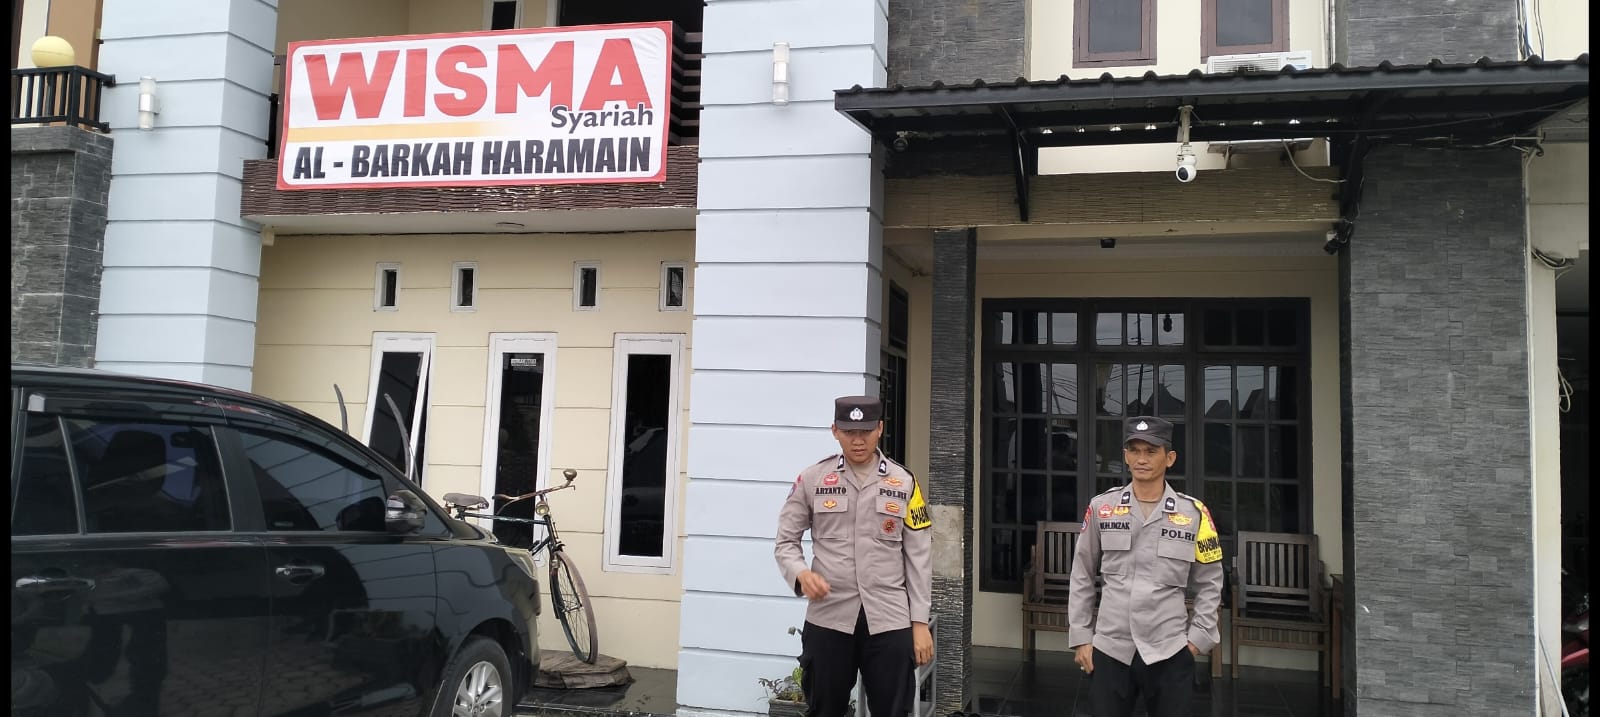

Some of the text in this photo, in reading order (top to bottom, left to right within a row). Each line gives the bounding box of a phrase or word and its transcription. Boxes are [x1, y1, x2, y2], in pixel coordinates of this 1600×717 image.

[303, 38, 653, 121] WISMA
[551, 103, 653, 134] Syariah
[292, 146, 326, 180] AL
[350, 141, 474, 179] BARKAH
[481, 136, 652, 176] HARAMAIN
[879, 488, 907, 500] POLRI
[1161, 528, 1196, 541] POLRI
